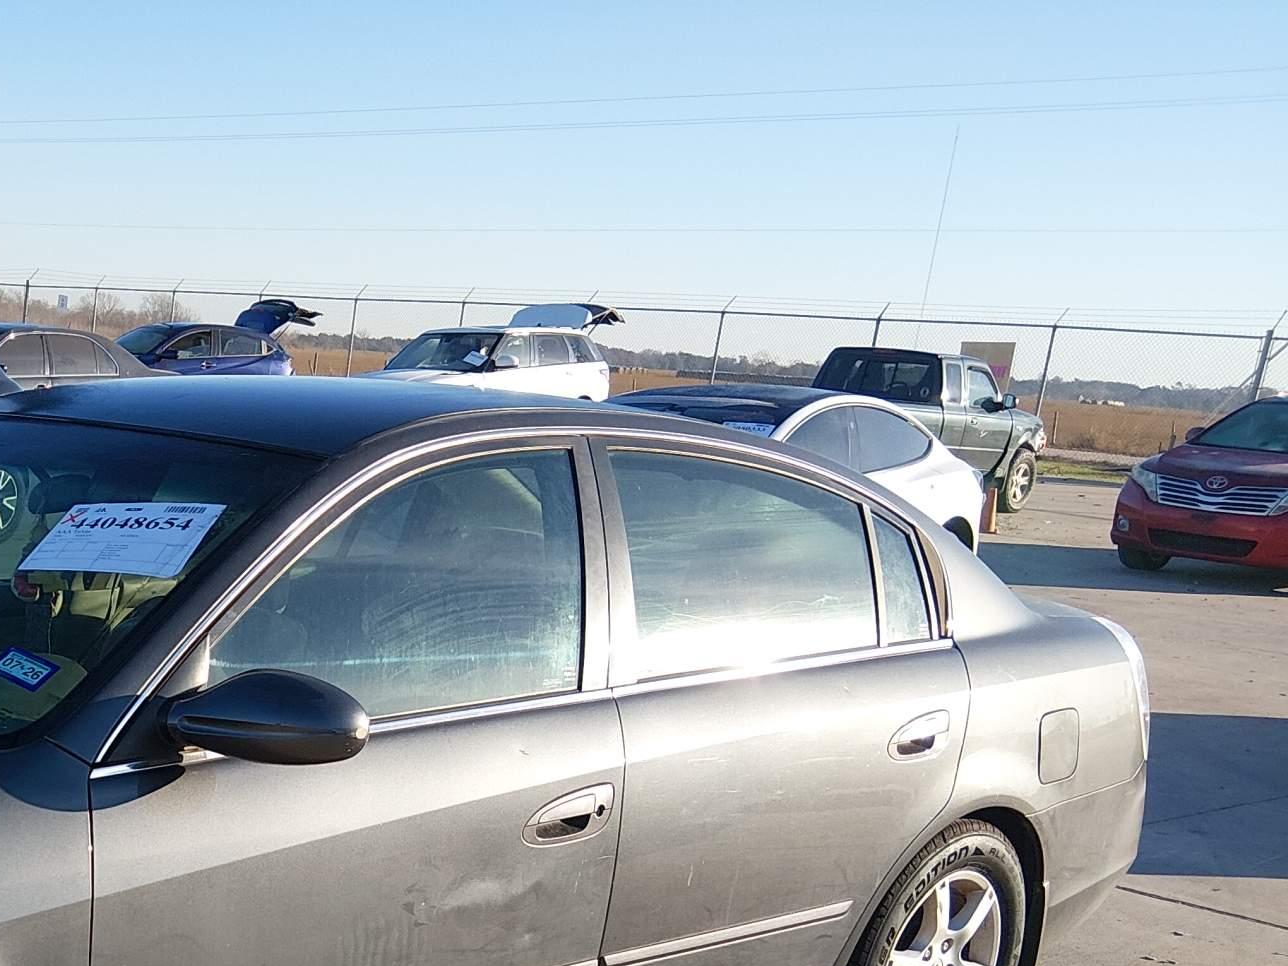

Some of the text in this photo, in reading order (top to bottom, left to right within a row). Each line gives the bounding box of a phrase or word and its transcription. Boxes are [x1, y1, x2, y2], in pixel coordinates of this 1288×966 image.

[71, 516, 193, 530] 44048654
[2, 657, 44, 680] 07 26
